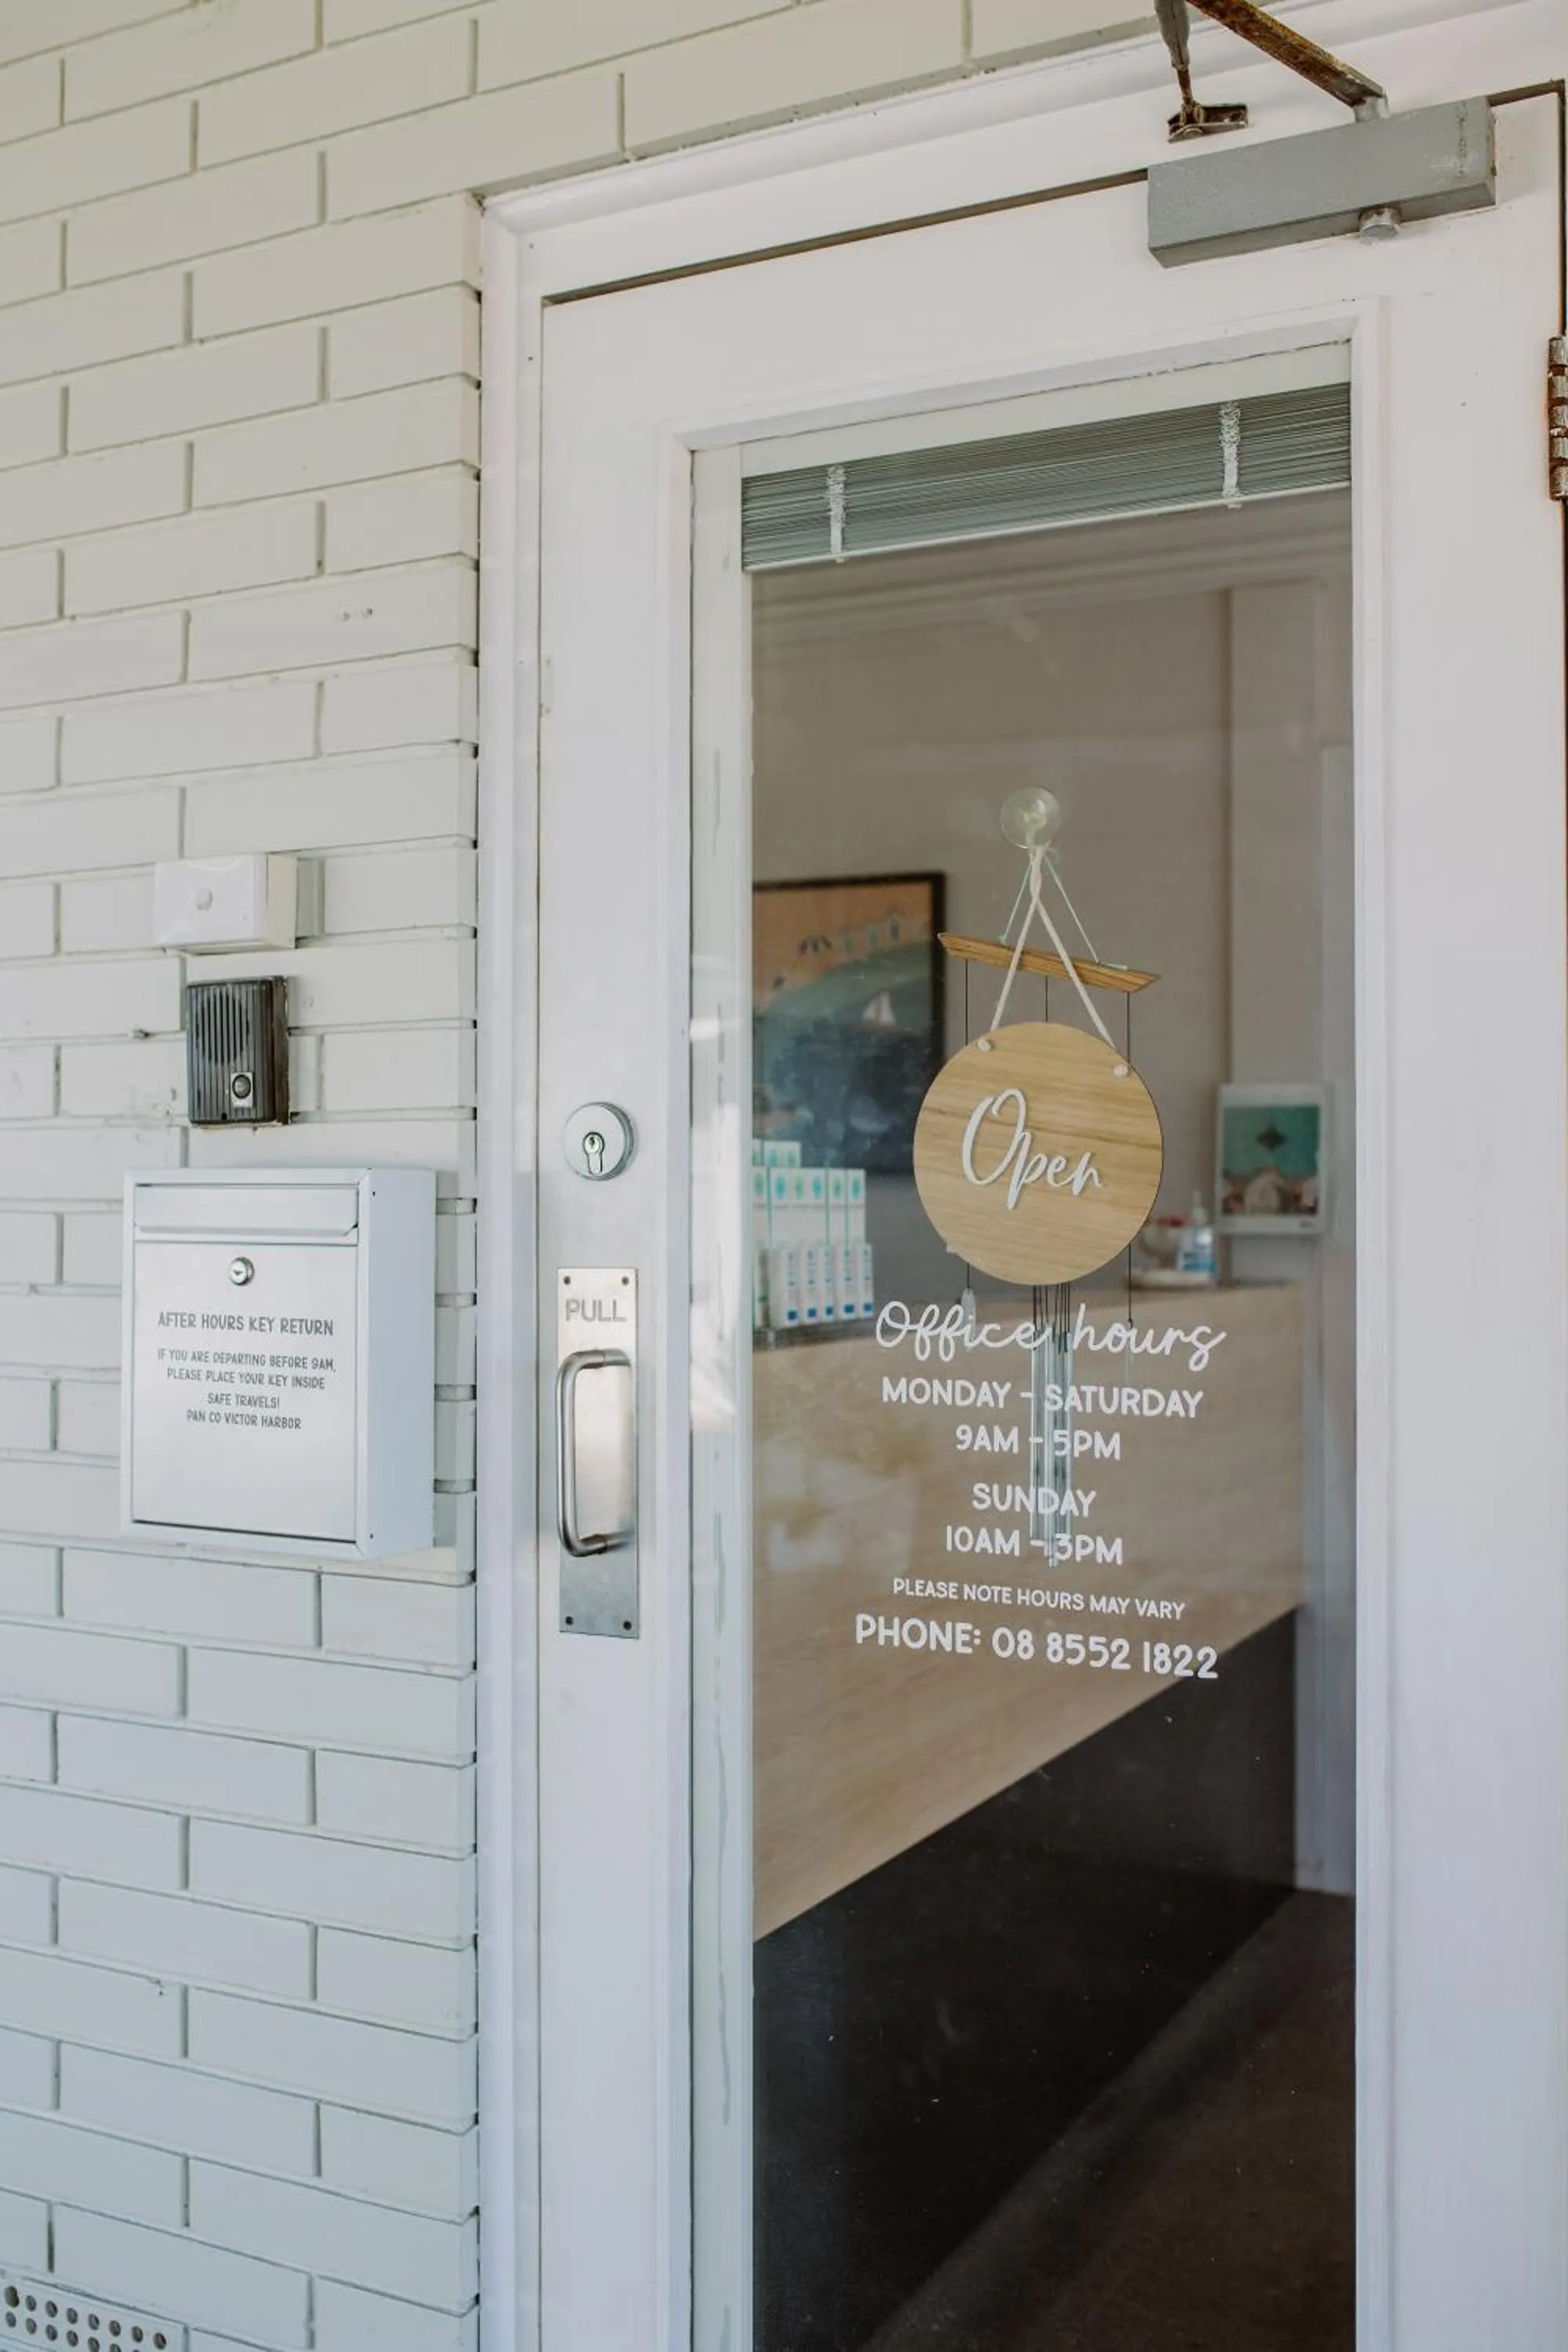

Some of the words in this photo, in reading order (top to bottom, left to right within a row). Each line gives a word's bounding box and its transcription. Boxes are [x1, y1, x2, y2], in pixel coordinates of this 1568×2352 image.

[962, 1088, 1103, 1210] Open
[158, 1312, 197, 1328] AFTER
[201, 1314, 244, 1330] HOURS
[249, 1316, 274, 1332] KEY
[280, 1318, 333, 1336] RETURN
[564, 1298, 627, 1323] PULL
[876, 1301, 1055, 1362] Office
[1072, 1302, 1227, 1371] hours
[158, 1348, 166, 1360] IF
[169, 1348, 187, 1361] YOU
[191, 1351, 209, 1363] ARE
[212, 1352, 266, 1367] DEPARTING
[270, 1355, 307, 1369] BEFORE
[311, 1357, 336, 1373] 9AM,
[167, 1367, 201, 1381] PLEASE
[206, 1370, 235, 1383] PLACE
[238, 1372, 264, 1385] YOUR
[267, 1374, 289, 1386] KEY
[291, 1376, 325, 1390] INSIDE
[208, 1392, 231, 1405] SAFE
[235, 1394, 280, 1409] TRAVELS!
[882, 1377, 1012, 1409] MONDAY
[1044, 1384, 1204, 1418] SATURDAY
[187, 1410, 205, 1422] PAN
[209, 1411, 222, 1423] CO
[224, 1413, 259, 1426] VICTOR
[261, 1415, 301, 1429] HARBOR
[956, 1425, 1019, 1454] 9AM
[1054, 1430, 1121, 1461] 5PM
[972, 1483, 1097, 1517] SUNDAY
[946, 1526, 1020, 1556] 10AM
[1054, 1534, 1123, 1565] 3PM
[893, 1577, 958, 1600] PLEASE
[963, 1584, 1011, 1605] NOTE
[1018, 1588, 1084, 1611] HOURS
[1089, 1594, 1131, 1616] MAY
[1135, 1599, 1186, 1621] VARY
[855, 1613, 982, 1654] PHONE:
[992, 1627, 1035, 1661] 08
[1047, 1632, 1131, 1670] 8552
[1143, 1640, 1218, 1679] 1822
